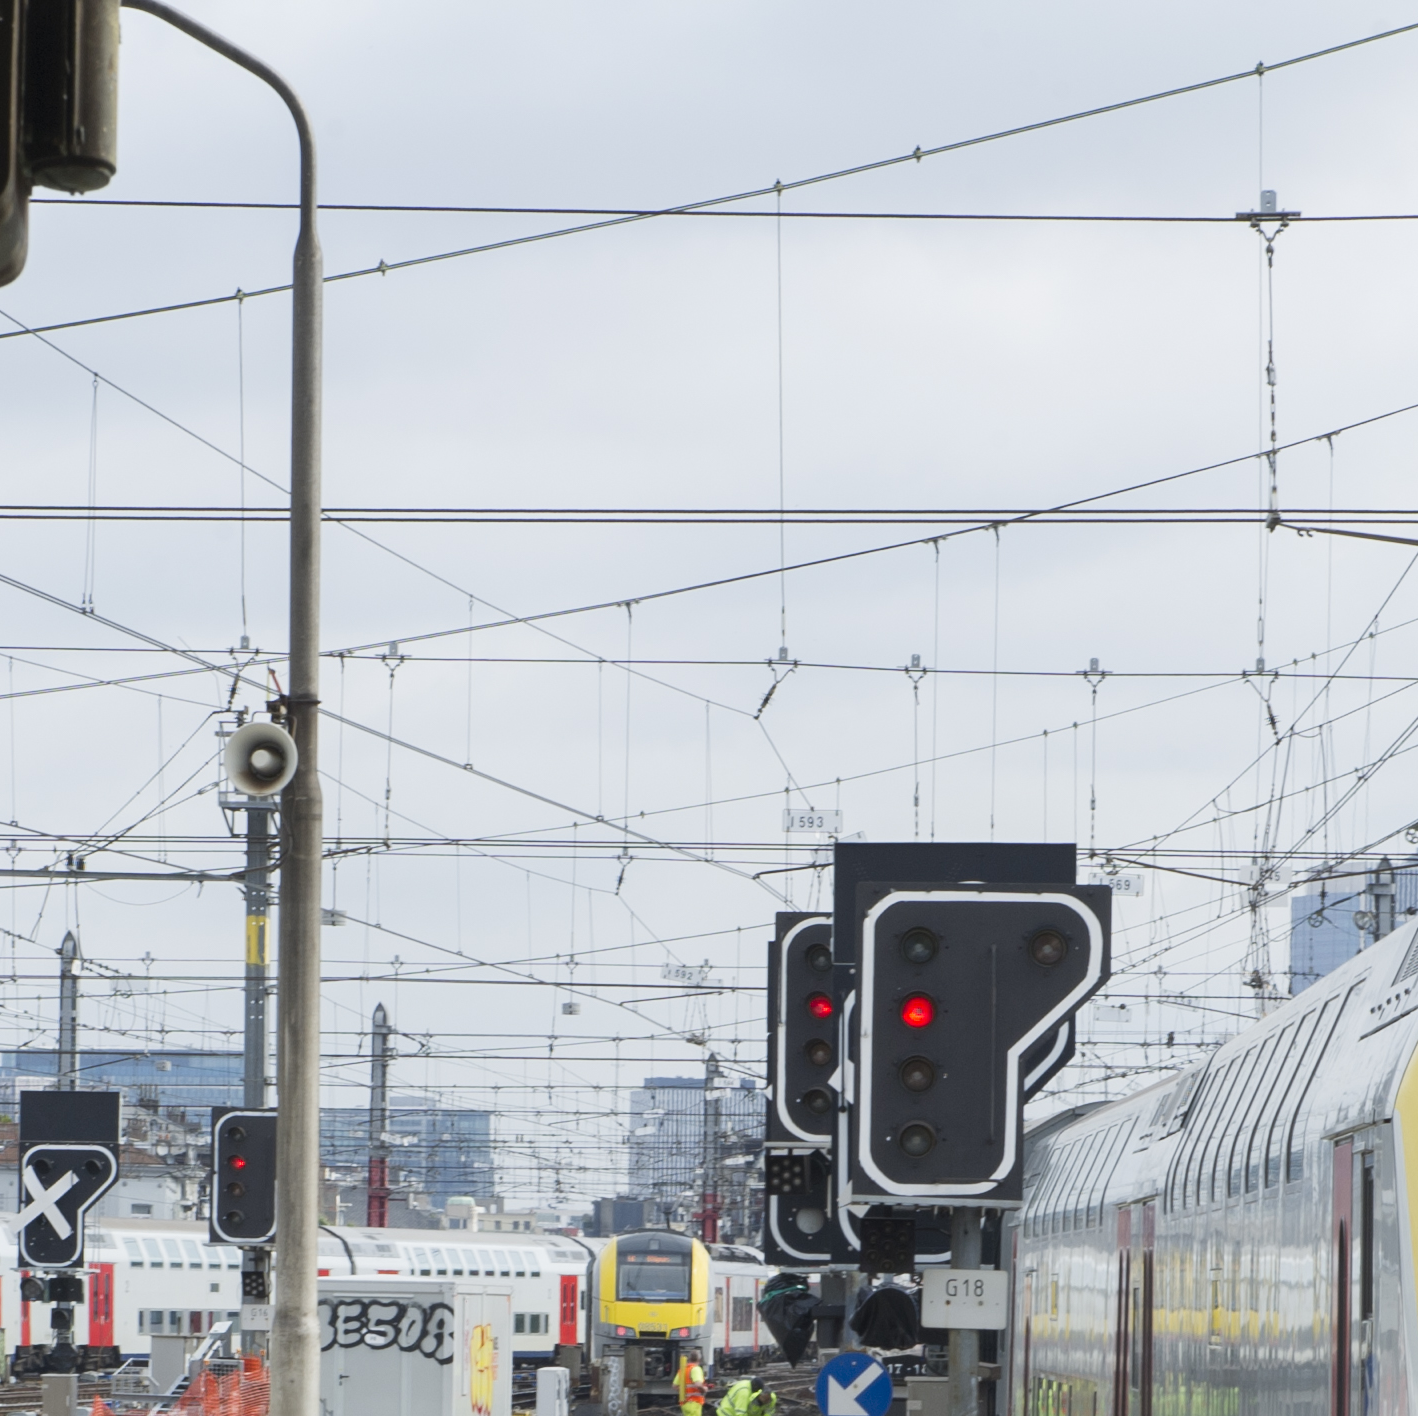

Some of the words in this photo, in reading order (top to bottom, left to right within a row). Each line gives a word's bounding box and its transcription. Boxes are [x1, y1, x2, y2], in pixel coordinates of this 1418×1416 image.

[799, 816, 824, 828] 593
[1108, 878, 1130, 891] 569
[674, 969, 693, 981] 592
[946, 1278, 985, 1297] G18
[250, 1307, 269, 1317] G16
